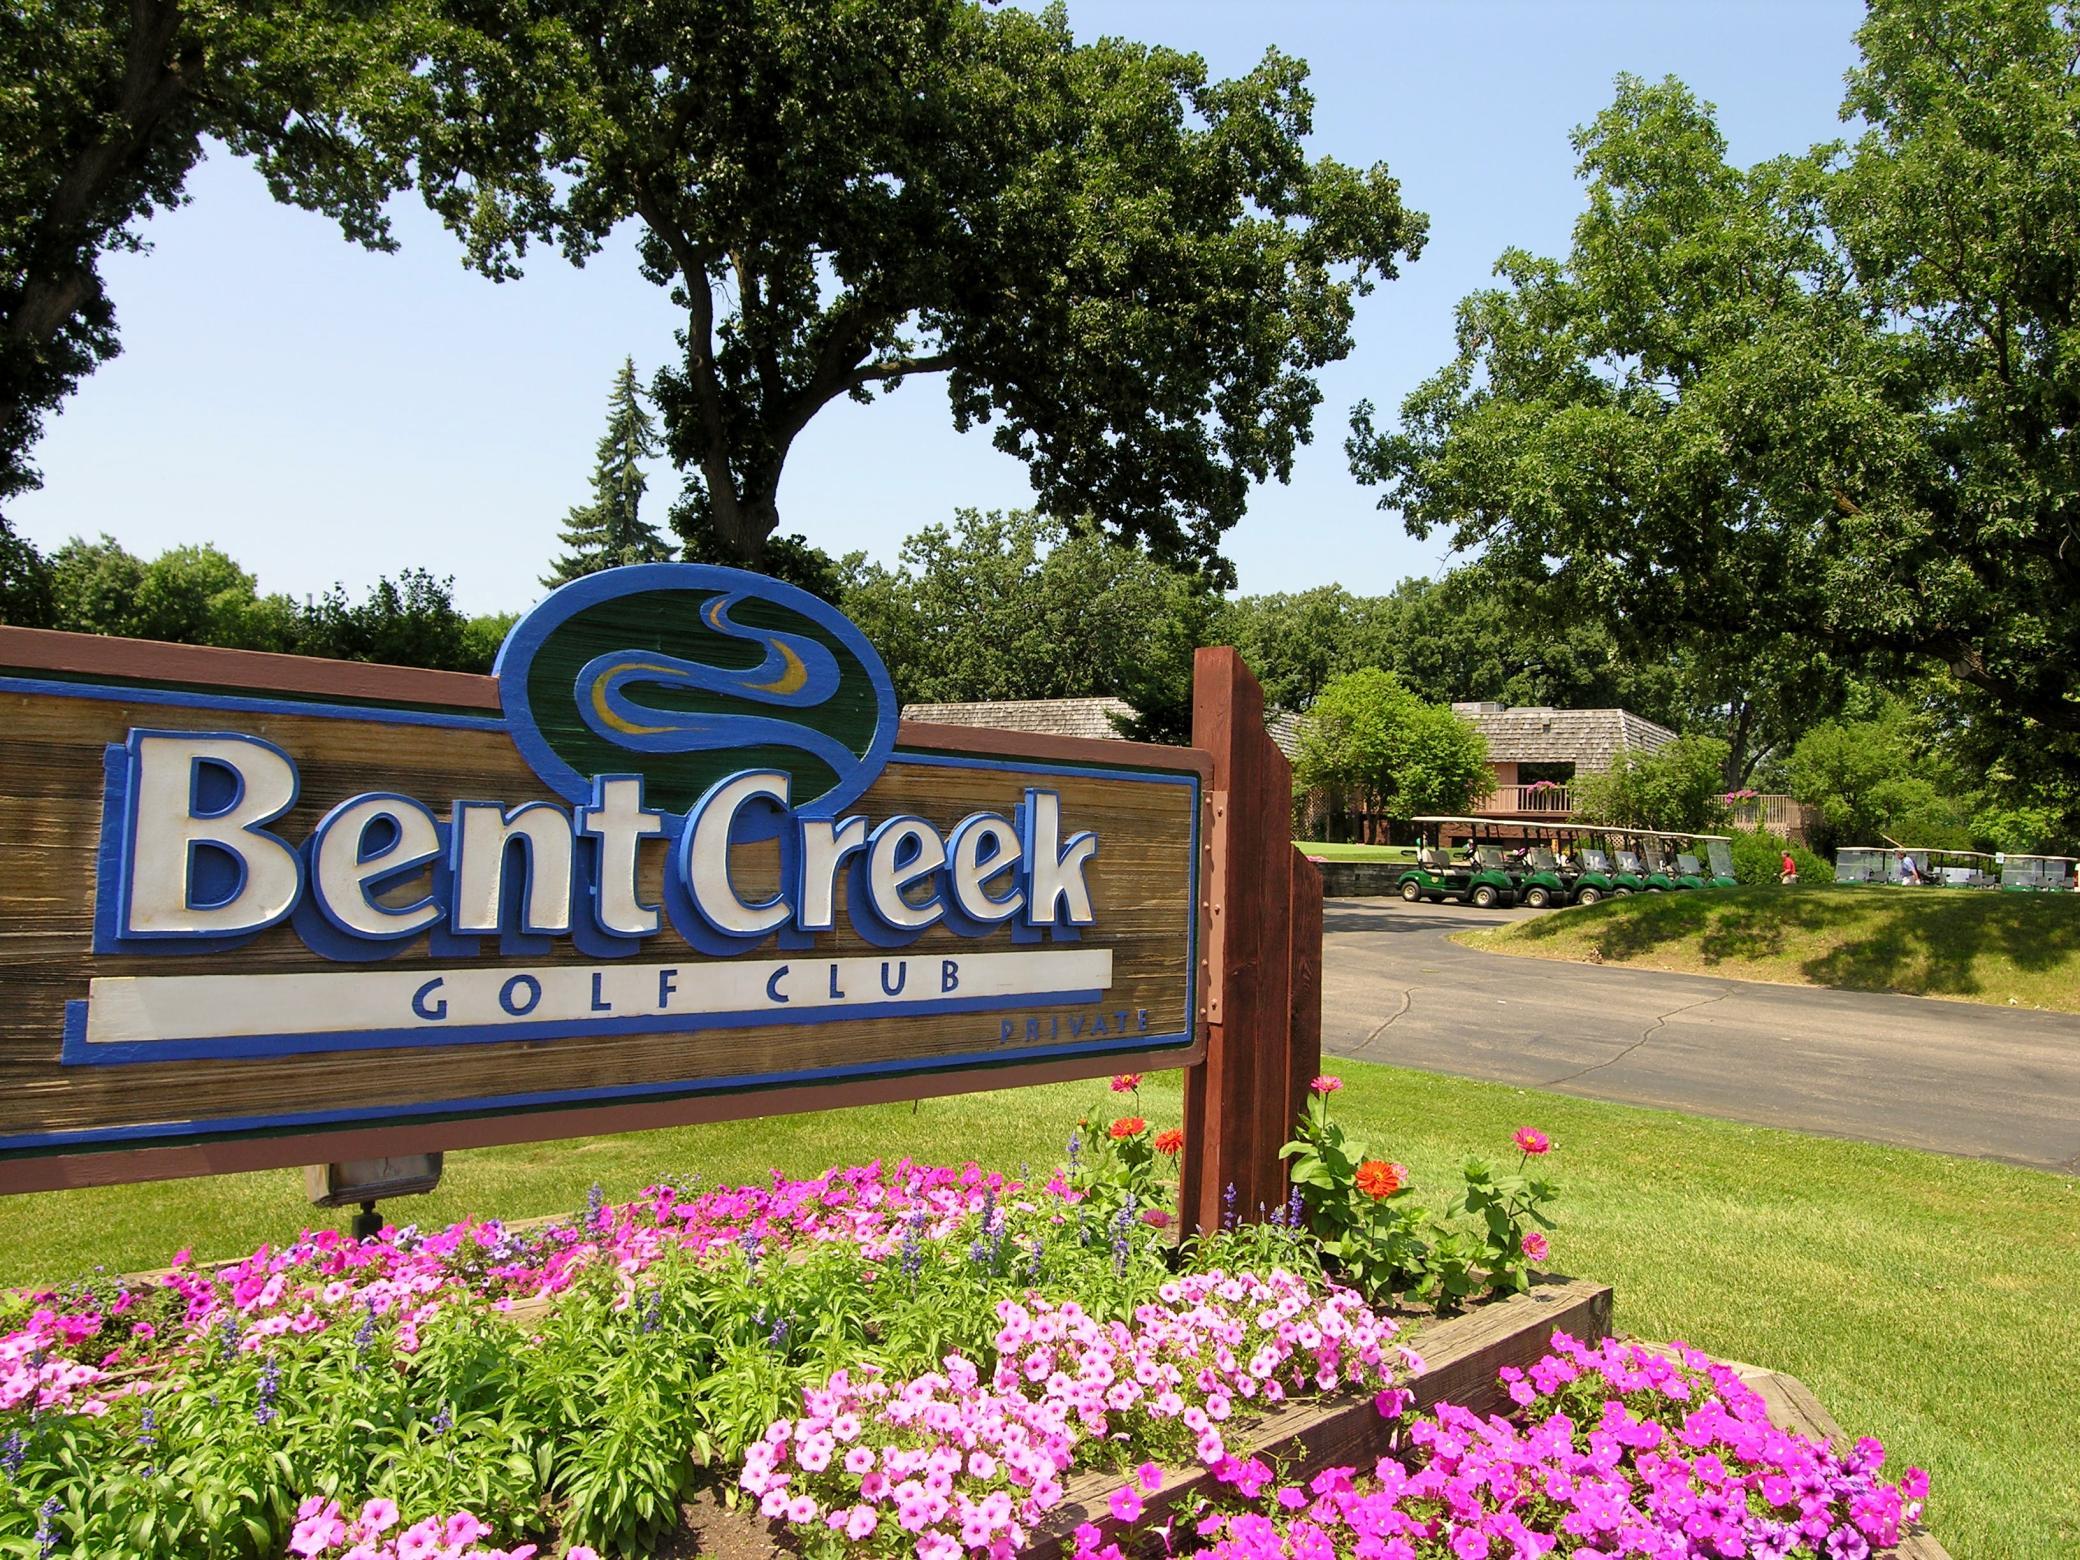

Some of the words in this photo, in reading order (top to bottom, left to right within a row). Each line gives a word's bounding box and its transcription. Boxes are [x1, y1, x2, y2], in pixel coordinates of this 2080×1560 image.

[411, 969, 678, 1020] GOLF
[765, 959, 960, 1003] CLUB
[1000, 1008, 1148, 1044] PRIVATE
